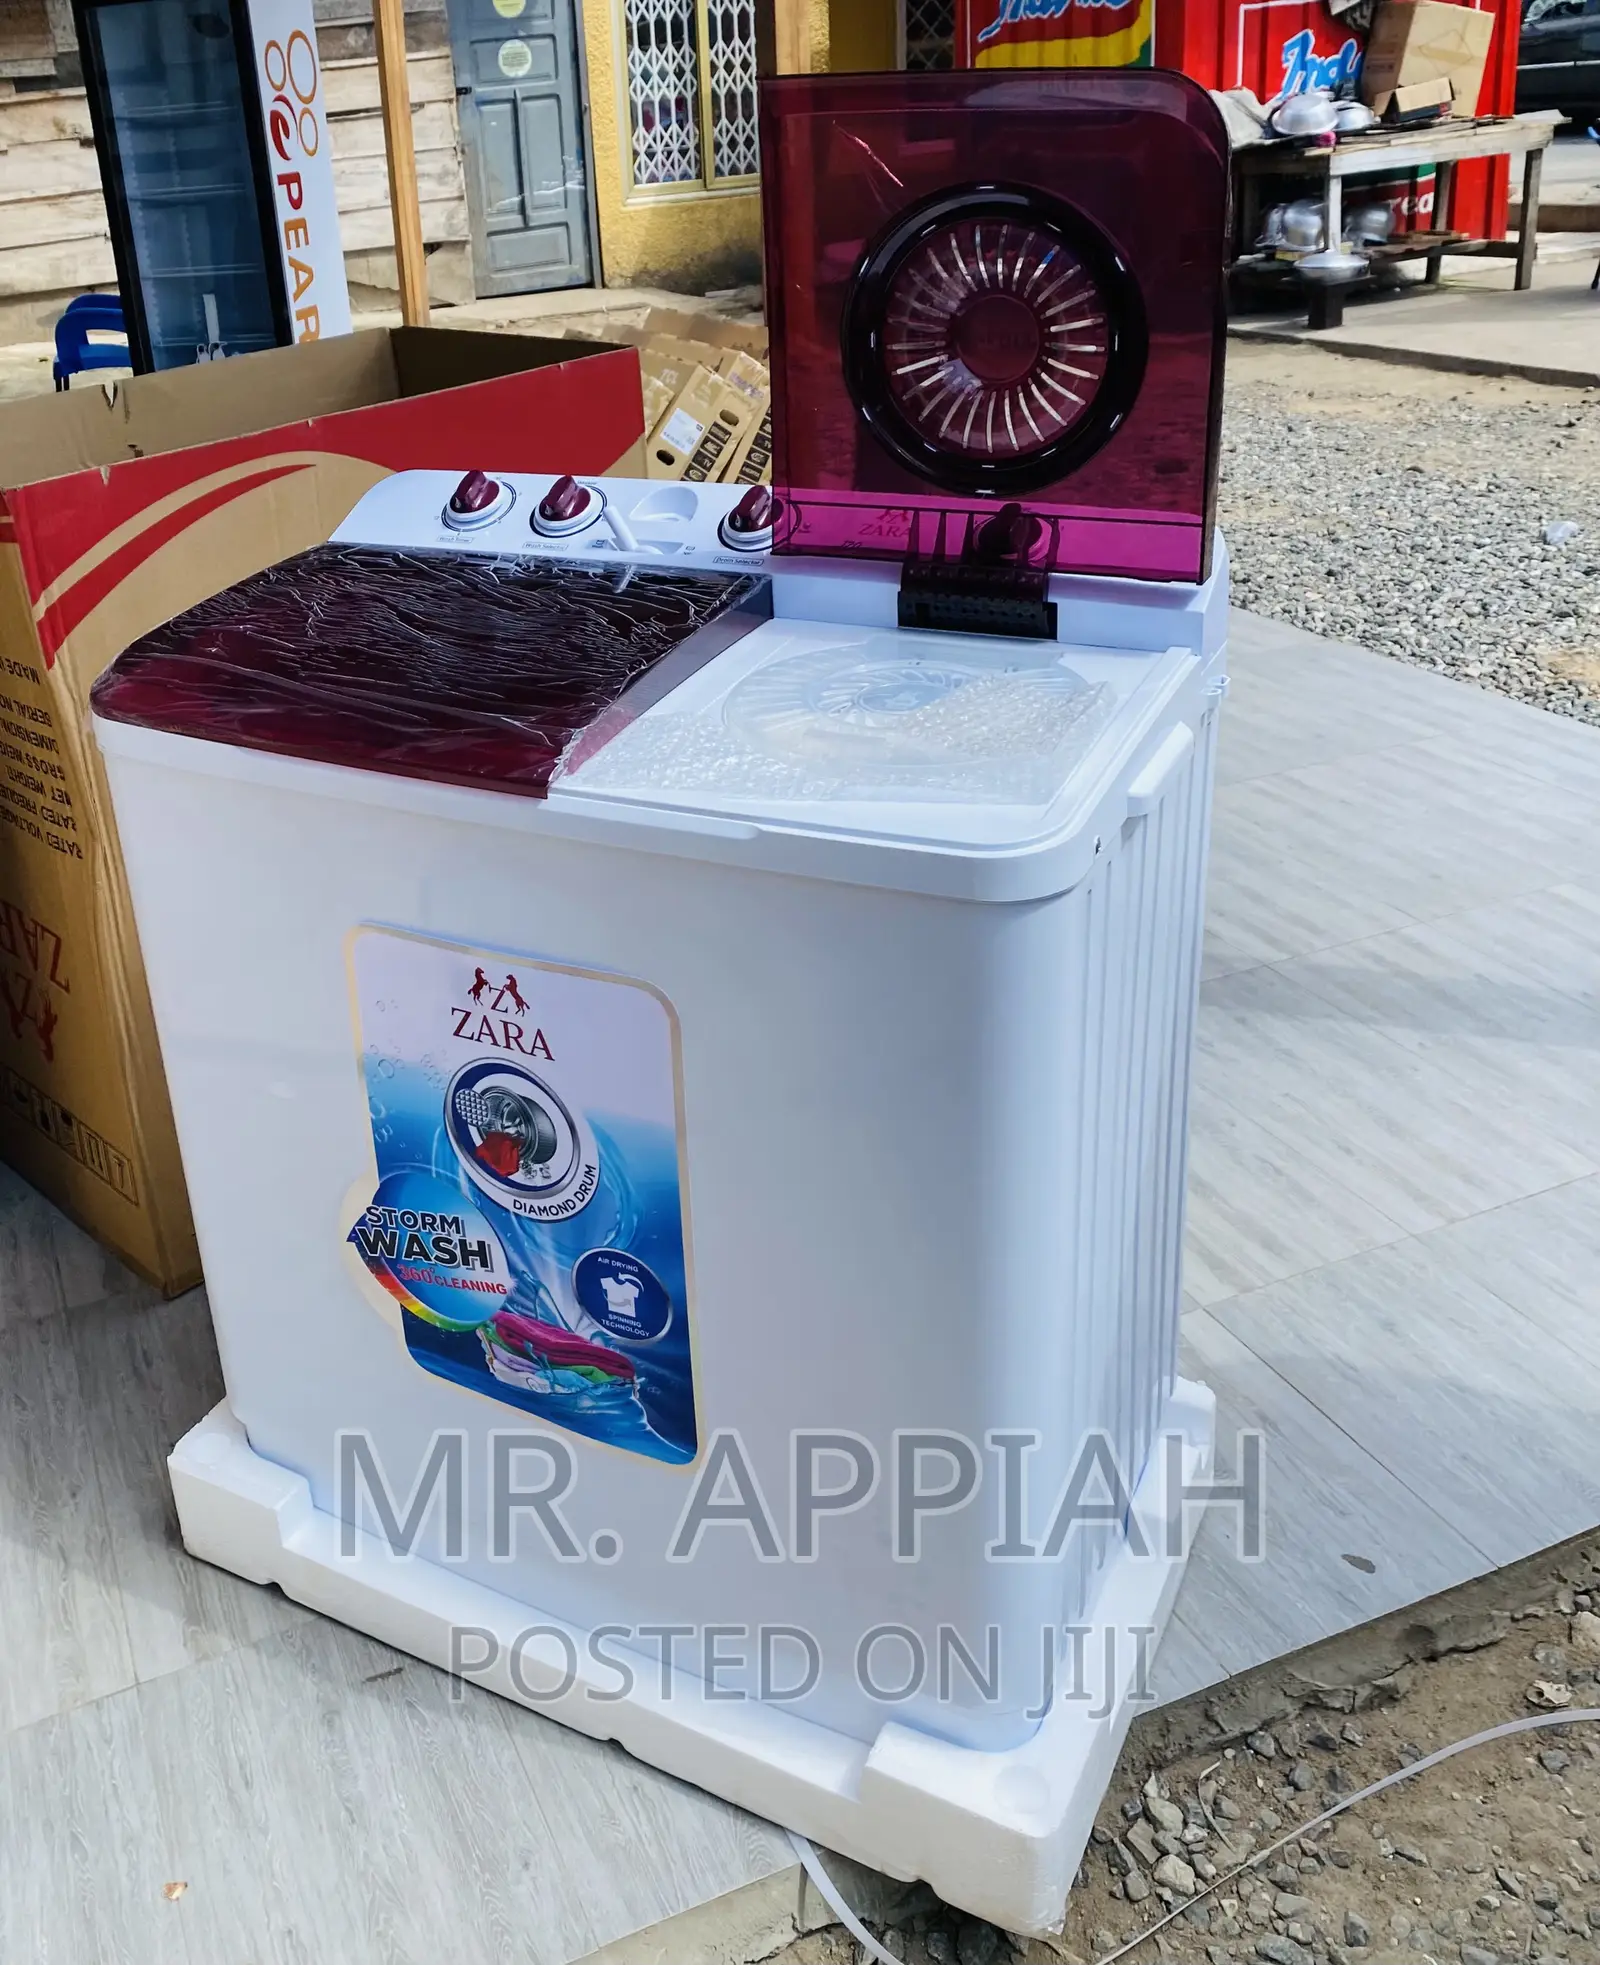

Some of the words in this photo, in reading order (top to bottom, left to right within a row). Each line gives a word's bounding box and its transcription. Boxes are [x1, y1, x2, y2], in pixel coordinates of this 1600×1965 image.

[6, 657, 40, 685] MADE
[13, 701, 52, 728] SERIAL
[26, 753, 66, 782] GROSS
[51, 788, 72, 807] NET
[41, 805, 78, 832] RATED
[47, 831, 84, 860] RATED
[451, 1006, 556, 1062] ZARA
[513, 1197, 577, 1218] DIAMOND
[573, 1164, 597, 1203] DRUM
[366, 1205, 463, 1237] STORM
[356, 1227, 492, 1271] WASH
[597, 1256, 610, 1265] AIR
[611, 1260, 639, 1273] DRYING
[601, 1318, 650, 1338] TECHNOLOGY
[608, 1313, 642, 1328] SPINNING
